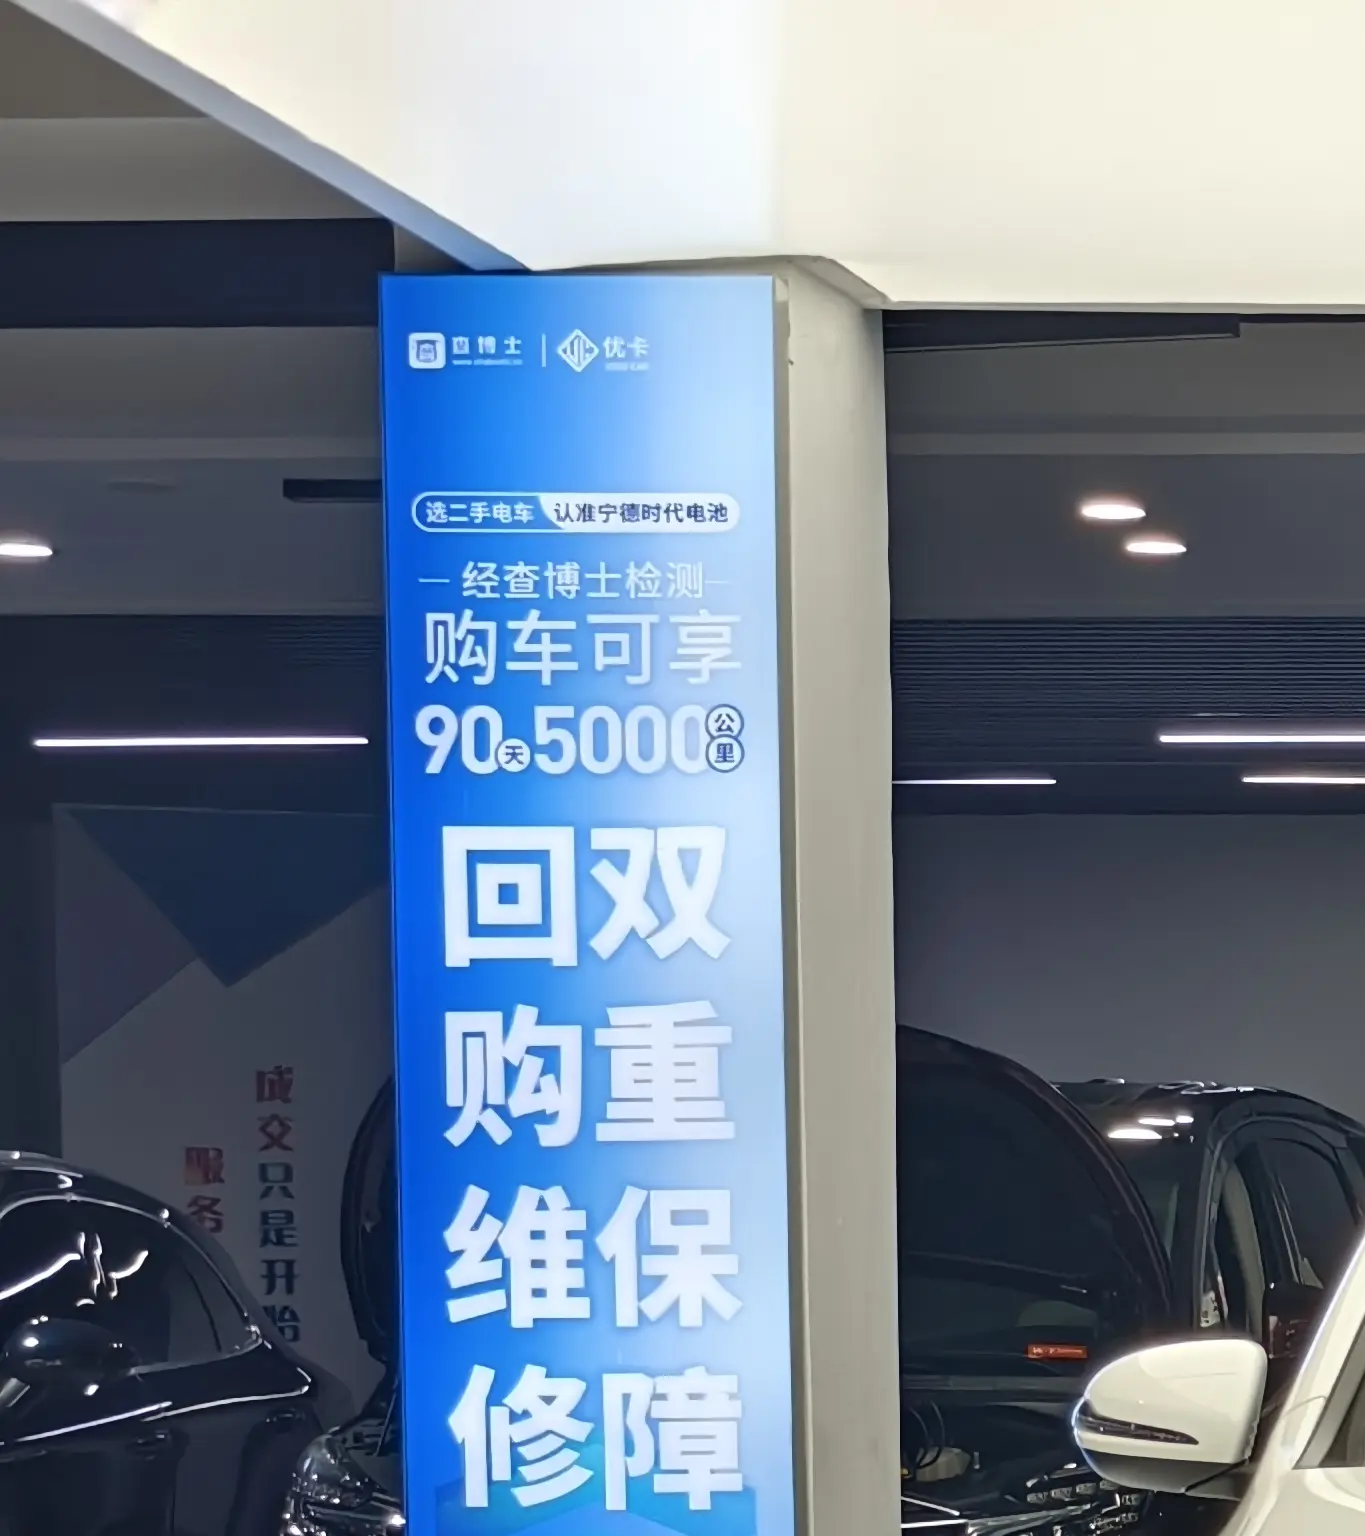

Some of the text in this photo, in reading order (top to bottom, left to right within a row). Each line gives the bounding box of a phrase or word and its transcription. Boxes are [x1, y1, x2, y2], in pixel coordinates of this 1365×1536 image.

[602, 335, 650, 358] 优卡
[425, 501, 729, 524] 选二手电车 认准宁德时代电池
[462, 560, 704, 600] 经查博士检测
[424, 609, 742, 685] 购车可享
[183, 1146, 226, 1234] 服务
[255, 1064, 301, 1343] 成交只是开始
